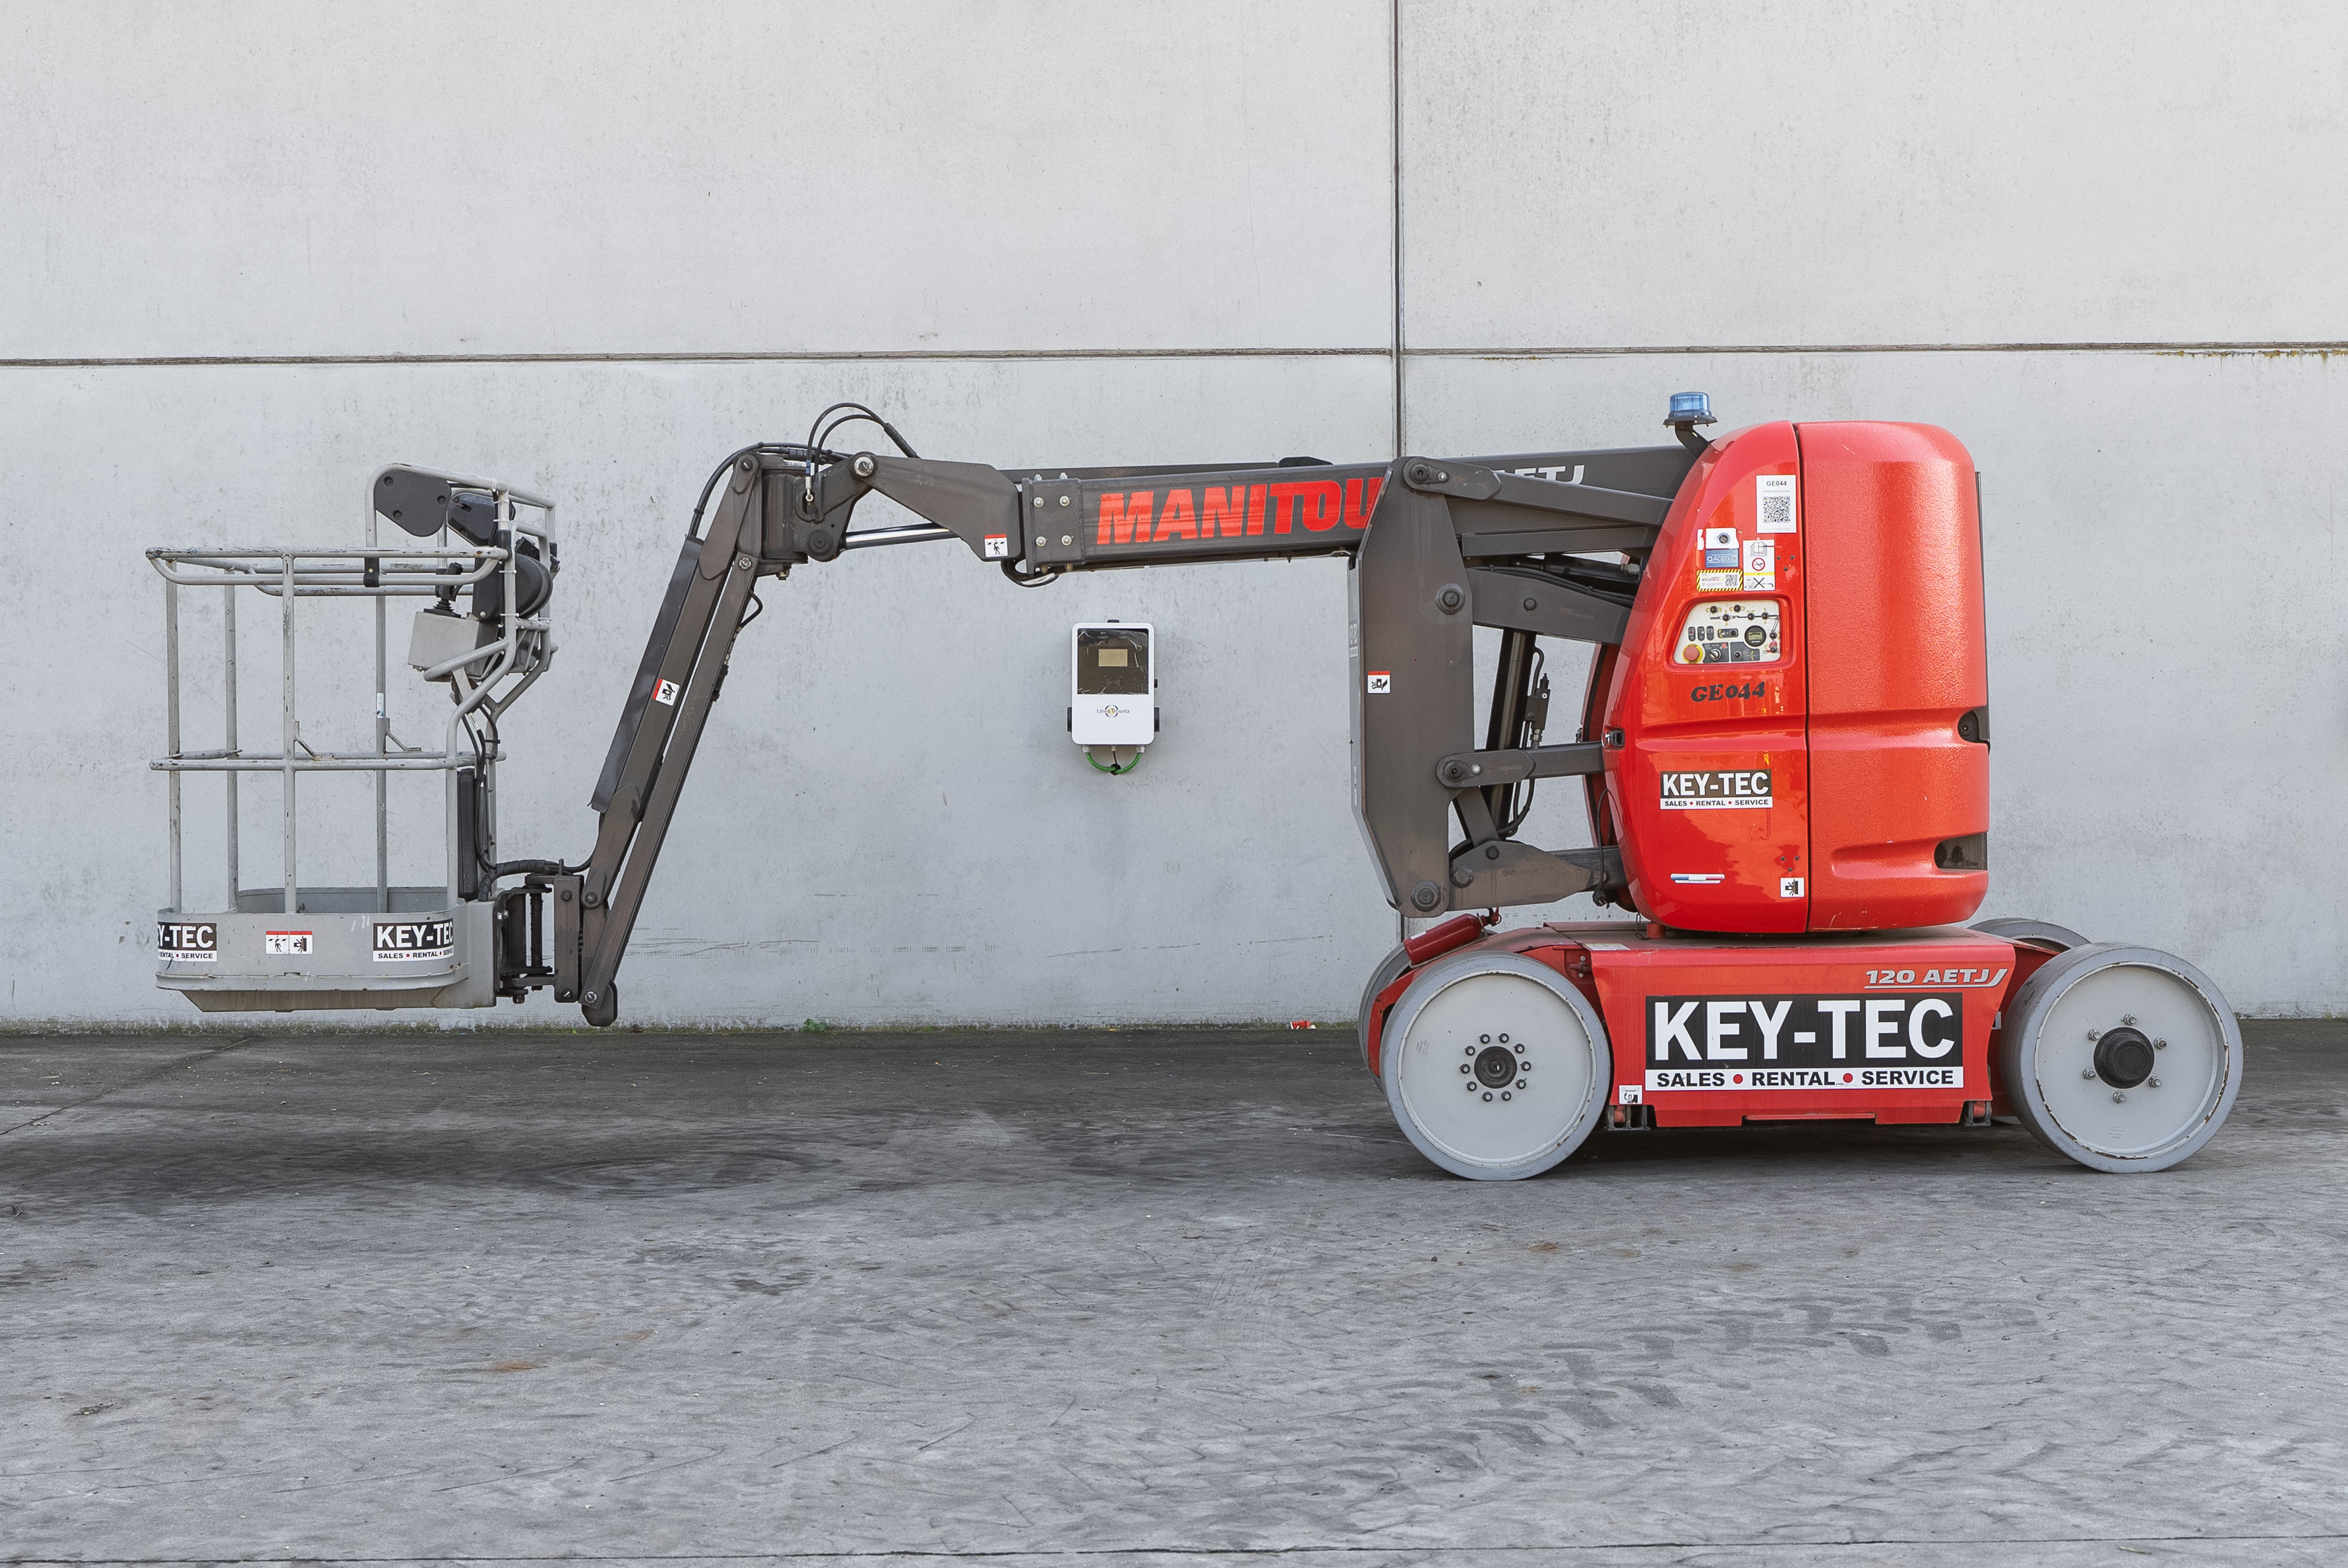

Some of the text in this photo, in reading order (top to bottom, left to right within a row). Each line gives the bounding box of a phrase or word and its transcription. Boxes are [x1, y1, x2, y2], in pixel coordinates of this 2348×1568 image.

[1097, 477, 1384, 545] MANITOU
[1690, 681, 1765, 702] GE044
[1663, 772, 1769, 796] KEY-TEC
[158, 924, 214, 948] Y-TEC
[377, 921, 453, 948] KEY-TEC
[1866, 969, 1990, 984] 120 AETJ
[1655, 998, 1955, 1060] KEY-TEC
[1657, 1070, 1954, 1087] SALES RENTAL SERVICE
